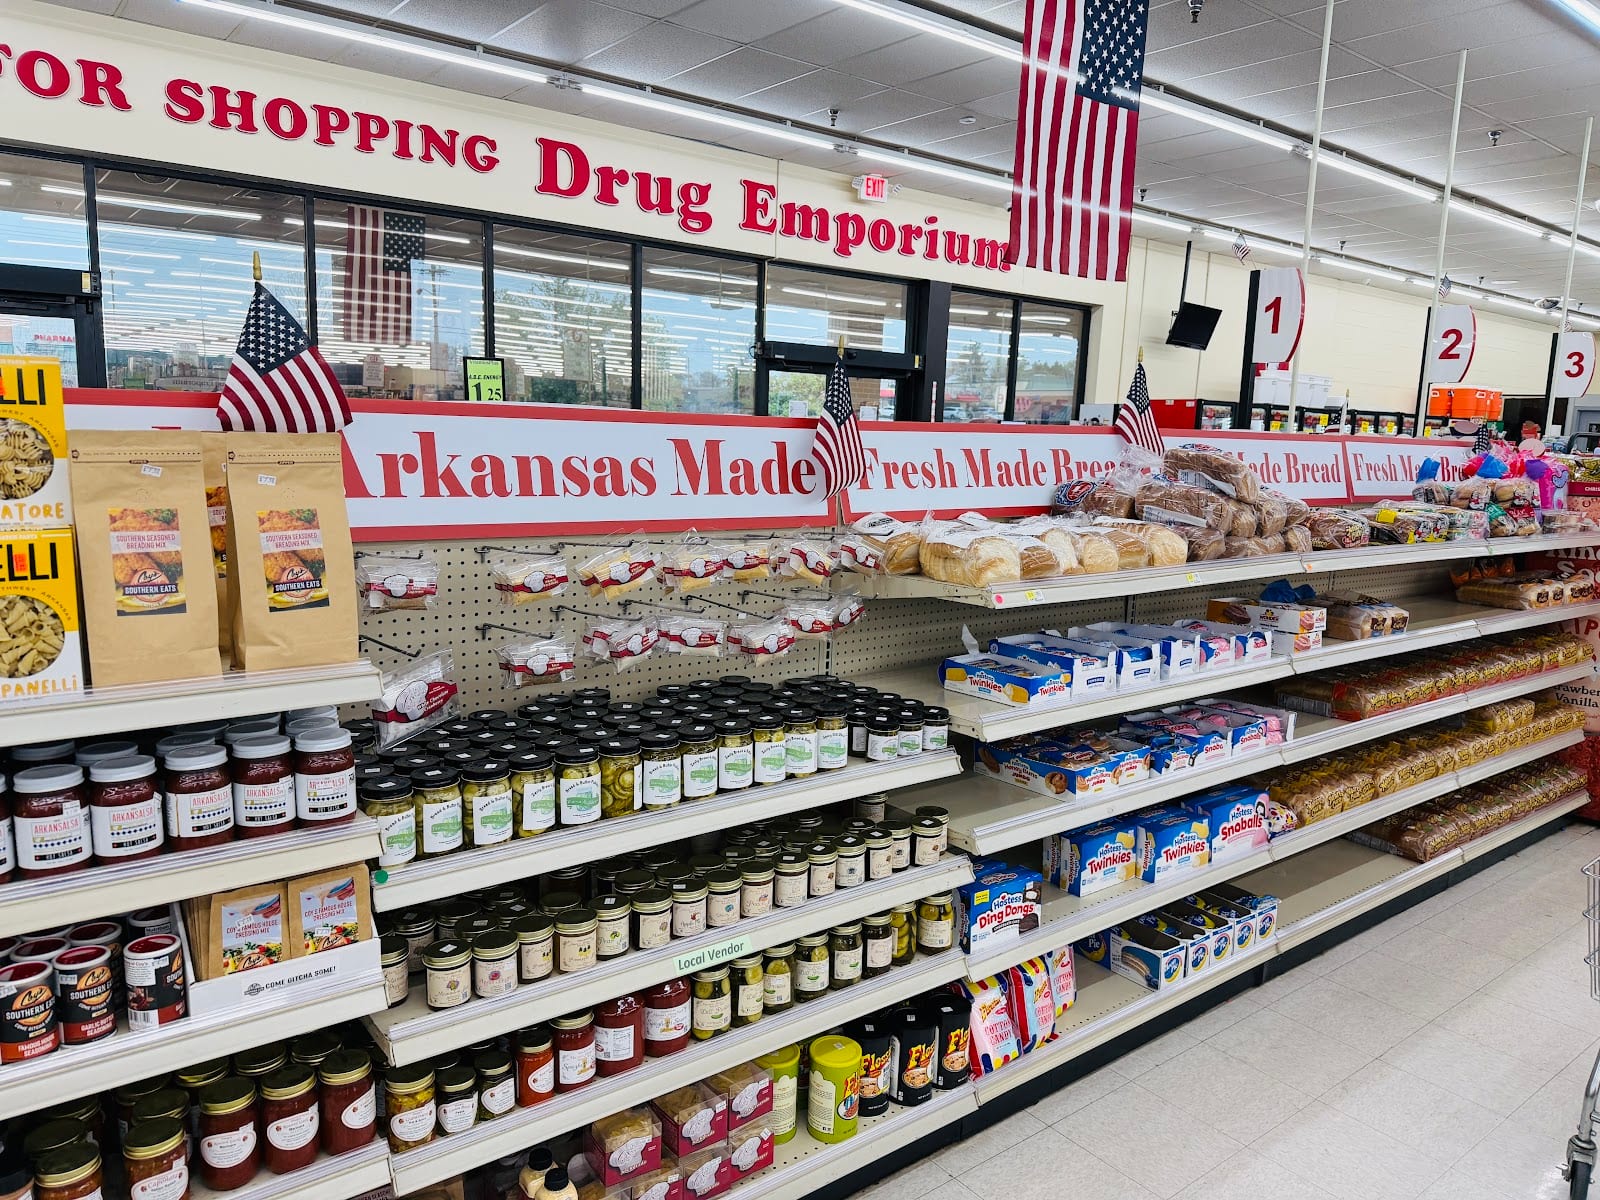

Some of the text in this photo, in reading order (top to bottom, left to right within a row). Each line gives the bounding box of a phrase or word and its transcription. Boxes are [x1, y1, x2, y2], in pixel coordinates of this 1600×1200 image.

[164, 79, 500, 173] SHOPPING
[535, 136, 713, 234] Drug
[739, 178, 1011, 272] Emporium
[866, 175, 886, 199] EXIT
[1264, 297, 1283, 334] 1
[34, 334, 75, 342] PHARMA
[1438, 328, 1462, 360] 2
[1564, 351, 1585, 378] 3
[667, 437, 818, 497] Made
[857, 448, 1124, 490] Fresh Made Brea
[1284, 452, 1342, 484] Bread
[1352, 453, 1398, 482] Fresh
[1441, 456, 1465, 482] Bre
[116, 533, 176, 543] SOUTHERN SEASONED
[126, 541, 167, 550] BREADING MIX
[265, 532, 318, 543] SOUTHERN SEASONED
[124, 584, 177, 595] SOUTHERN EATS
[275, 580, 321, 592] SOUTHERN EATS
[968, 676, 1002, 693] Twinkies
[1039, 685, 1065, 697] Twinkies
[1555, 692, 1599, 708] Vanilla
[246, 786, 284, 798] ARKANSALS
[1231, 807, 1253, 821] Hostess
[1221, 814, 1263, 841] Snoballs
[1174, 833, 1196, 846] Hostess
[1099, 843, 1122, 857] Hostess
[1163, 841, 1206, 863] Twinkies
[1087, 851, 1132, 875] Twinkies
[318, 904, 337, 915] FAMOUS
[337, 901, 353, 910] HOUSE
[993, 894, 1022, 910] Hostess
[259, 919, 278, 929] HOUSE
[978, 910, 1004, 929] Ding
[1005, 903, 1034, 917] Dongs
[1088, 938, 1100, 948] Pie
[678, 941, 744, 970] Local Vendor
[265, 966, 336, 990] COME GITCHA SOME!
[70, 984, 106, 1001] SOUTHERN
[5, 1003, 45, 1020] SOUTHERN
[80, 1020, 99, 1032] GARLIC
[985, 1019, 1012, 1036] COTTON
[990, 1030, 1012, 1046] CANDY
[17, 1041, 40, 1052] FAMOUS
